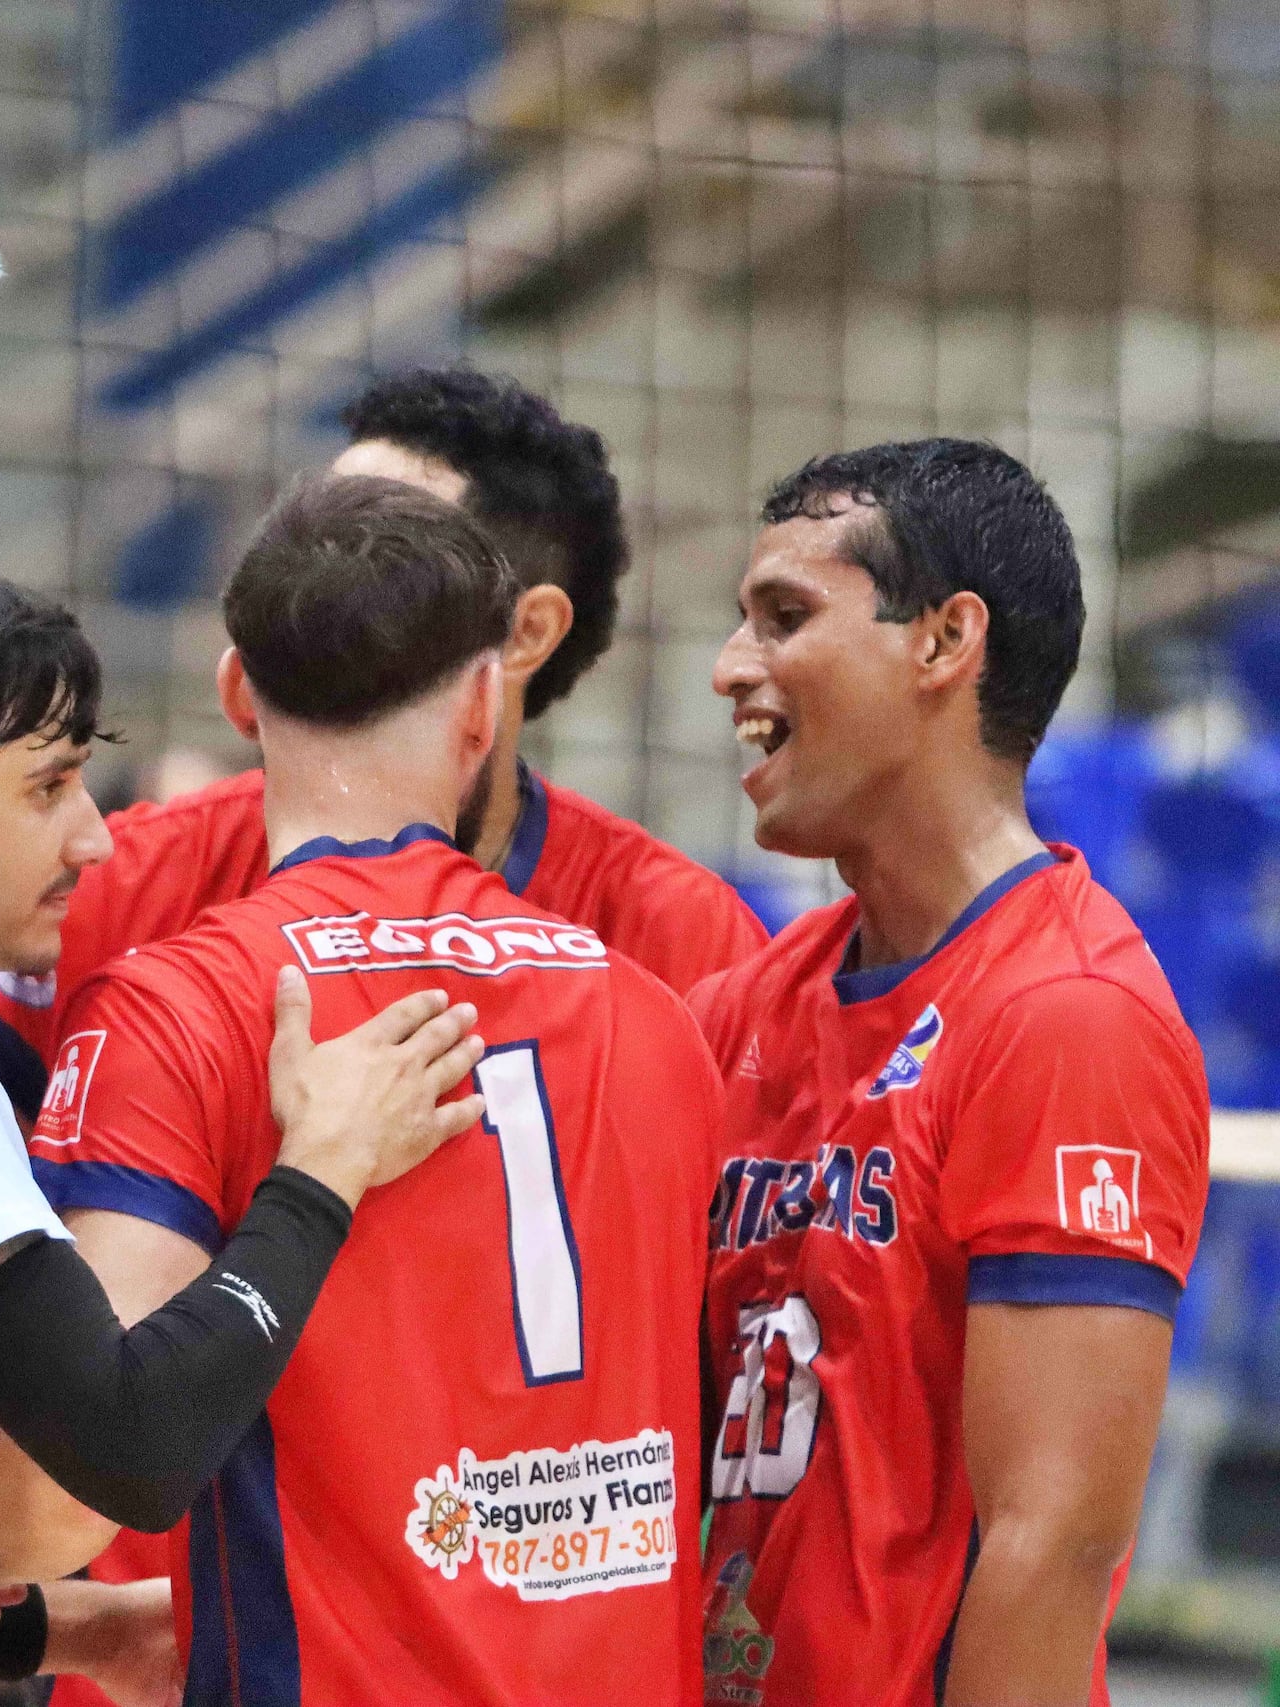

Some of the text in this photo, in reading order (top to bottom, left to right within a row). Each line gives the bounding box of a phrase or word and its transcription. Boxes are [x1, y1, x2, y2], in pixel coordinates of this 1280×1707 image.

[473, 1038, 584, 1388] 1
[463, 1459, 521, 1495] Ángel
[529, 1455, 581, 1486] Alexis
[474, 1497, 572, 1534] Seguros
[579, 1493, 597, 1525] y
